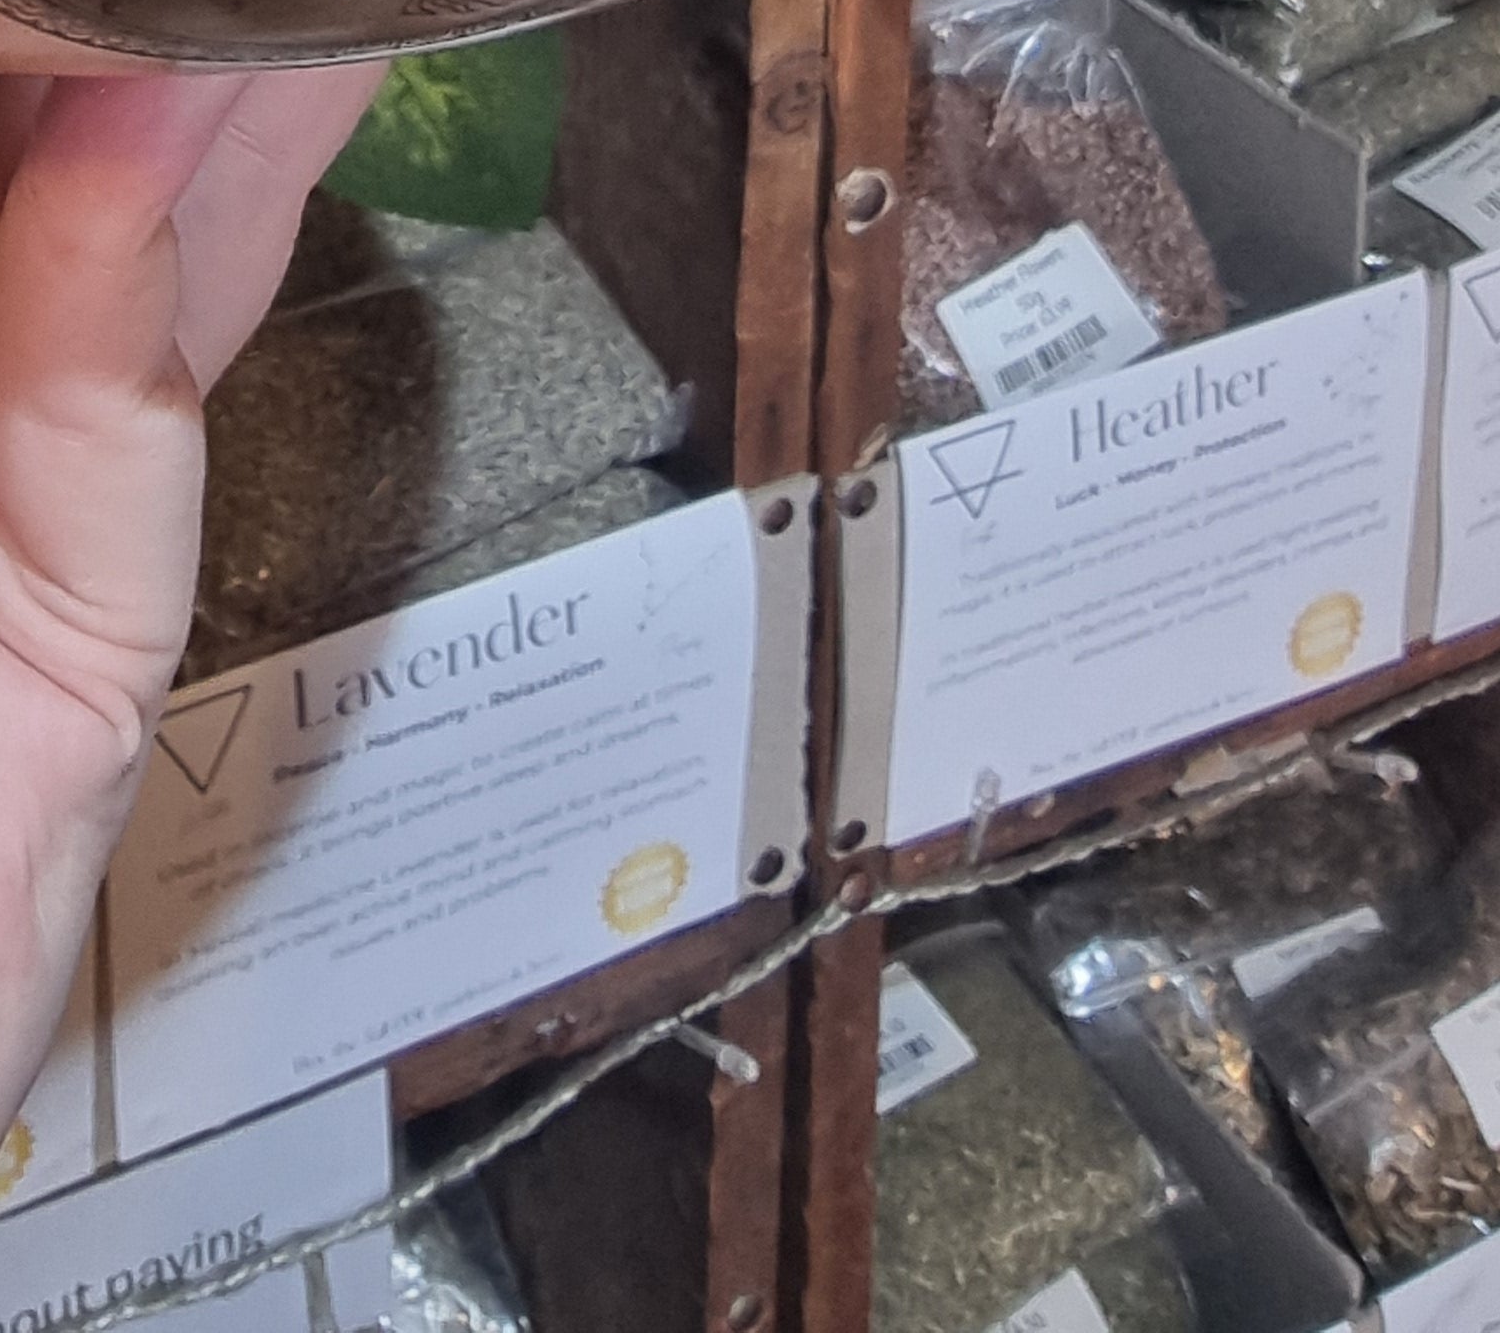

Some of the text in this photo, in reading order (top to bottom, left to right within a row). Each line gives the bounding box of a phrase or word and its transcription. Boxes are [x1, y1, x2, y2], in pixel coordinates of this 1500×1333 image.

[1069, 359, 1280, 464] Heather
[1054, 483, 1100, 511] Luck
[293, 591, 589, 733] Lavender
[365, 706, 469, 752] Harmony
[488, 657, 605, 708] Relaxation
[397, 761, 463, 795] magic
[103, 1212, 264, 1311] paying
